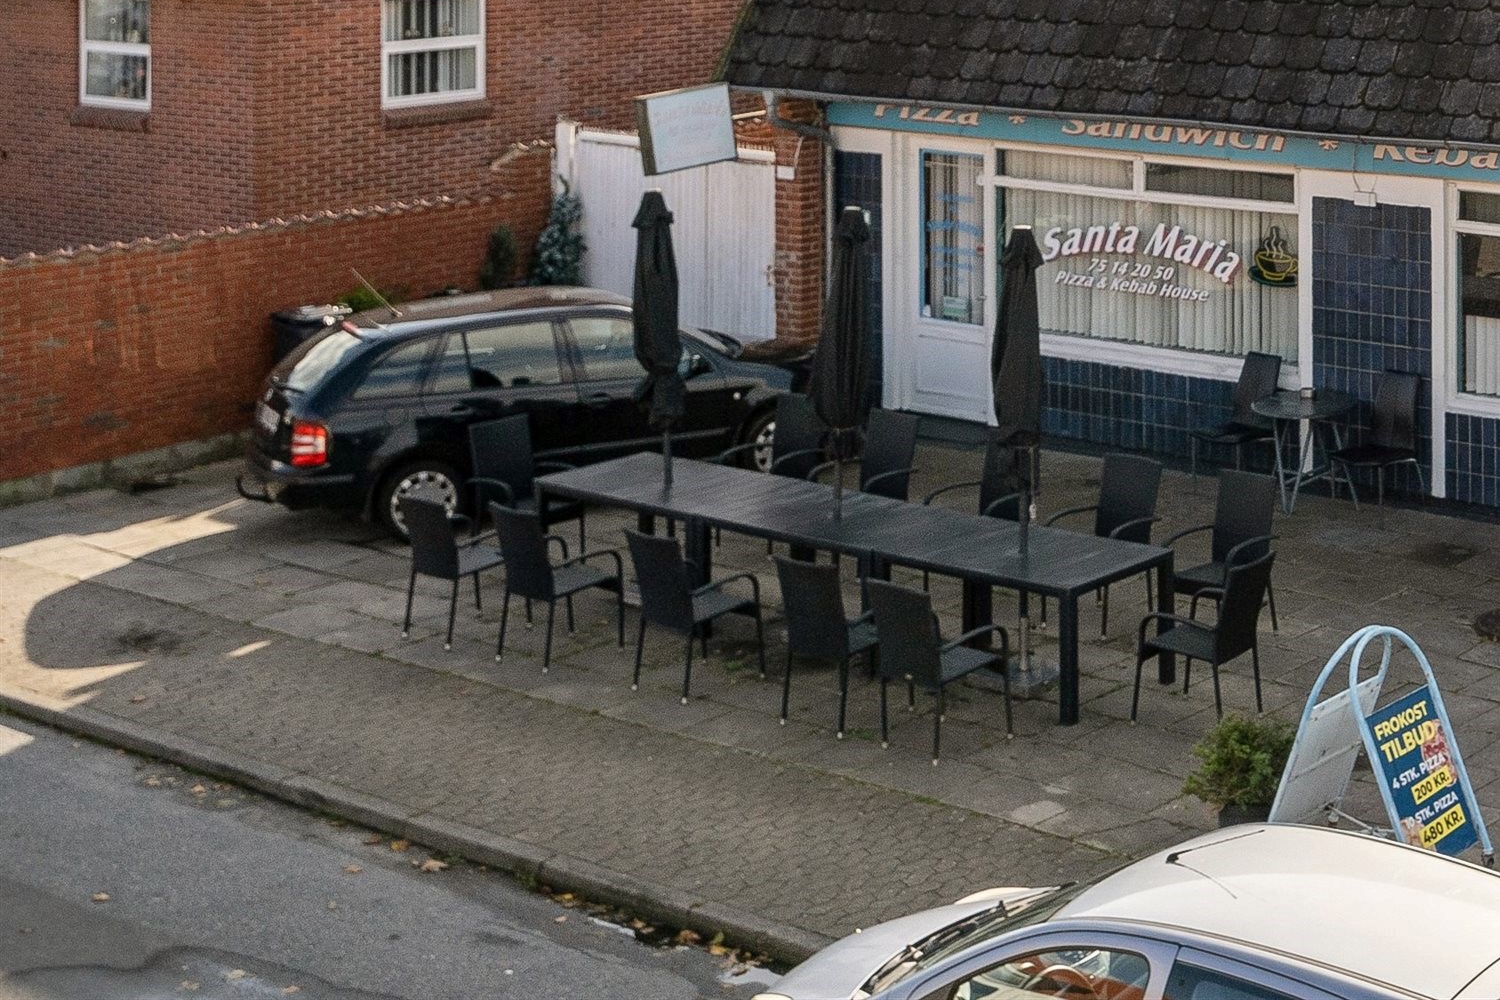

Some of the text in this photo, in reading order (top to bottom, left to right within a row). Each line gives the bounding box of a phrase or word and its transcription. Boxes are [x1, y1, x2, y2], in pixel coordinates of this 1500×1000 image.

[1043, 221, 1242, 284] Santa Maria
[1088, 258, 1175, 281] 75 14 20 50
[1055, 270, 1209, 302] Pizza & Kebab House
[1374, 700, 1428, 741] FROKOST
[1380, 720, 1436, 763] TILBUD
[1392, 752, 1447, 789] 4 STK. PIZZA
[1414, 771, 1450, 800] 200 KR.
[1405, 790, 1459, 829] 10 STK. PIZZA
[1423, 811, 1463, 844] 480 KR.
